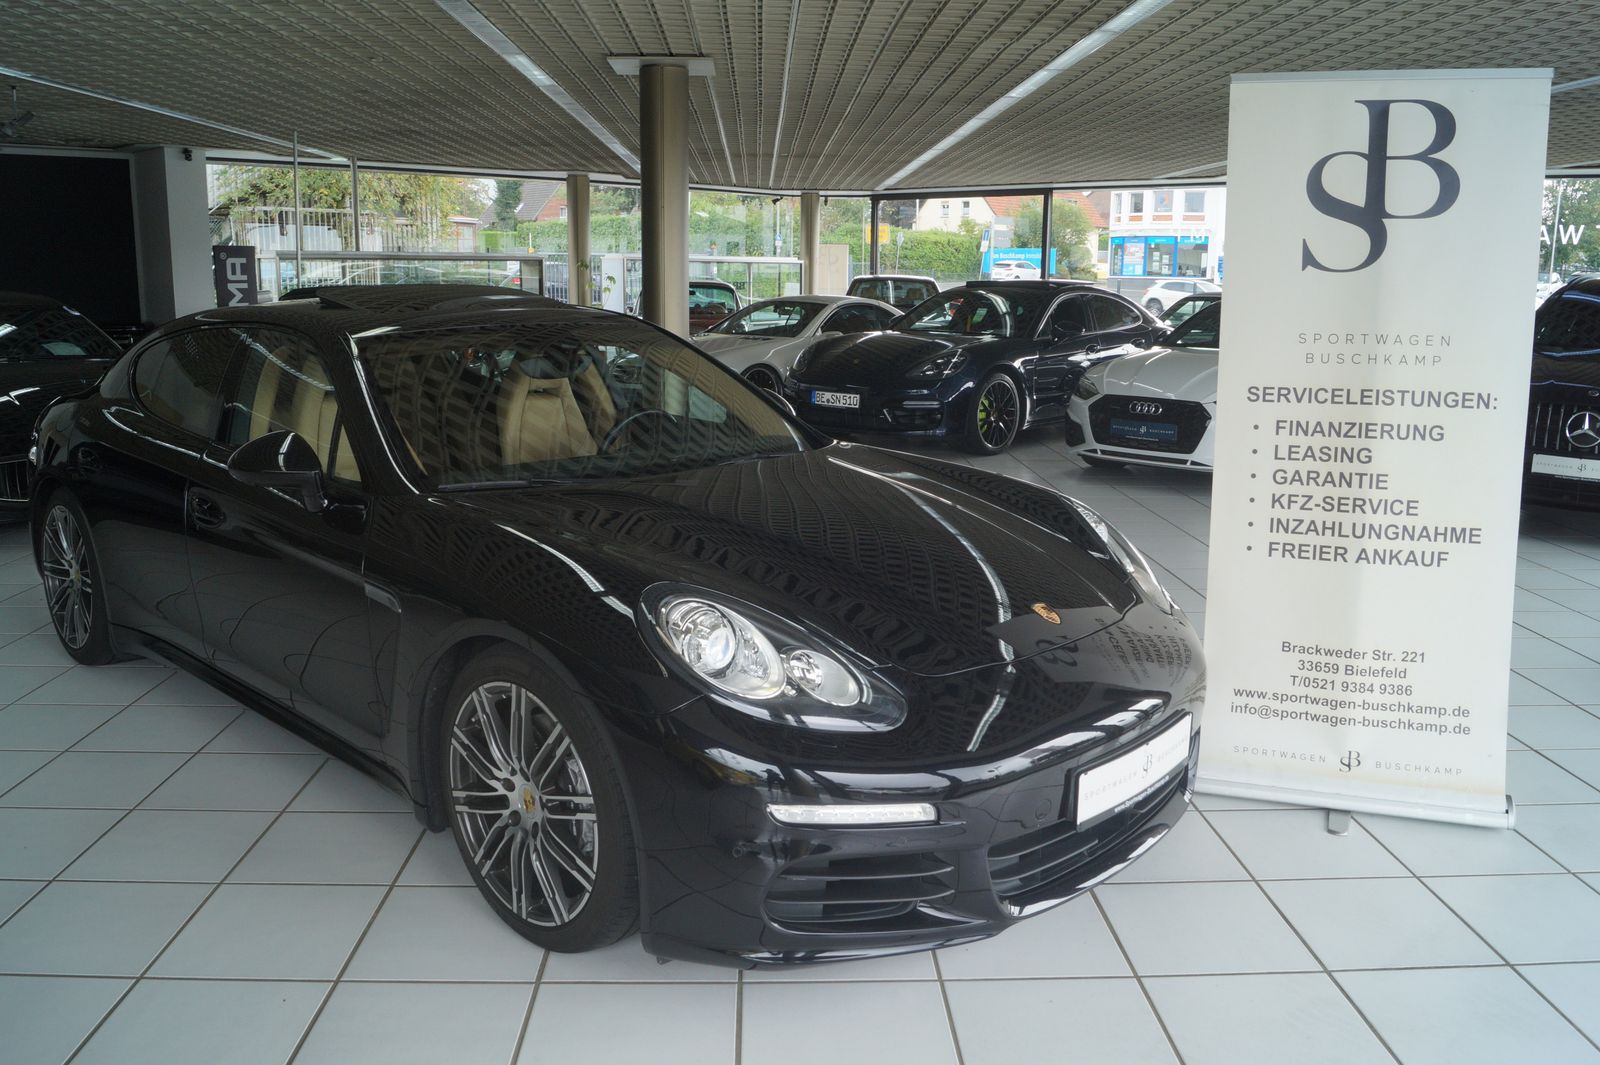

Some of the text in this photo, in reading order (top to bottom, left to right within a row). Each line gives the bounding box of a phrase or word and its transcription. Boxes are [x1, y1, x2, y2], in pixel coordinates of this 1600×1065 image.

[1298, 332, 1452, 347] SPORTWAGEN
[1305, 352, 1442, 366] BUSCHKAMP
[831, 394, 841, 405] SN
[842, 395, 858, 406] 510
[1247, 386, 1498, 410] SERVICELEISTUNGEN:
[1275, 420, 1445, 441] FINANZIERUNG
[1274, 444, 1373, 464] LEASING
[1272, 469, 1389, 490] GARANTIE
[1271, 493, 1420, 516] KFZ-SERVICE
[1269, 517, 1483, 544] INZAHLUNGNAHME
[1268, 541, 1450, 568] FREIER ANKAUF
[1281, 641, 1425, 663] Brackweder Str. 221
[1297, 659, 1407, 679] 33659 Bielefeld
[1290, 675, 1413, 696] T/0521 9384 9386
[1233, 688, 1471, 719] www.sportwagen-buschkamp.de
[1230, 702, 1471, 736] info@sportwagen-buschkamp.de
[1233, 745, 1326, 763] SPORTWAGEN
[1375, 761, 1462, 776] BUSCHKAMP
